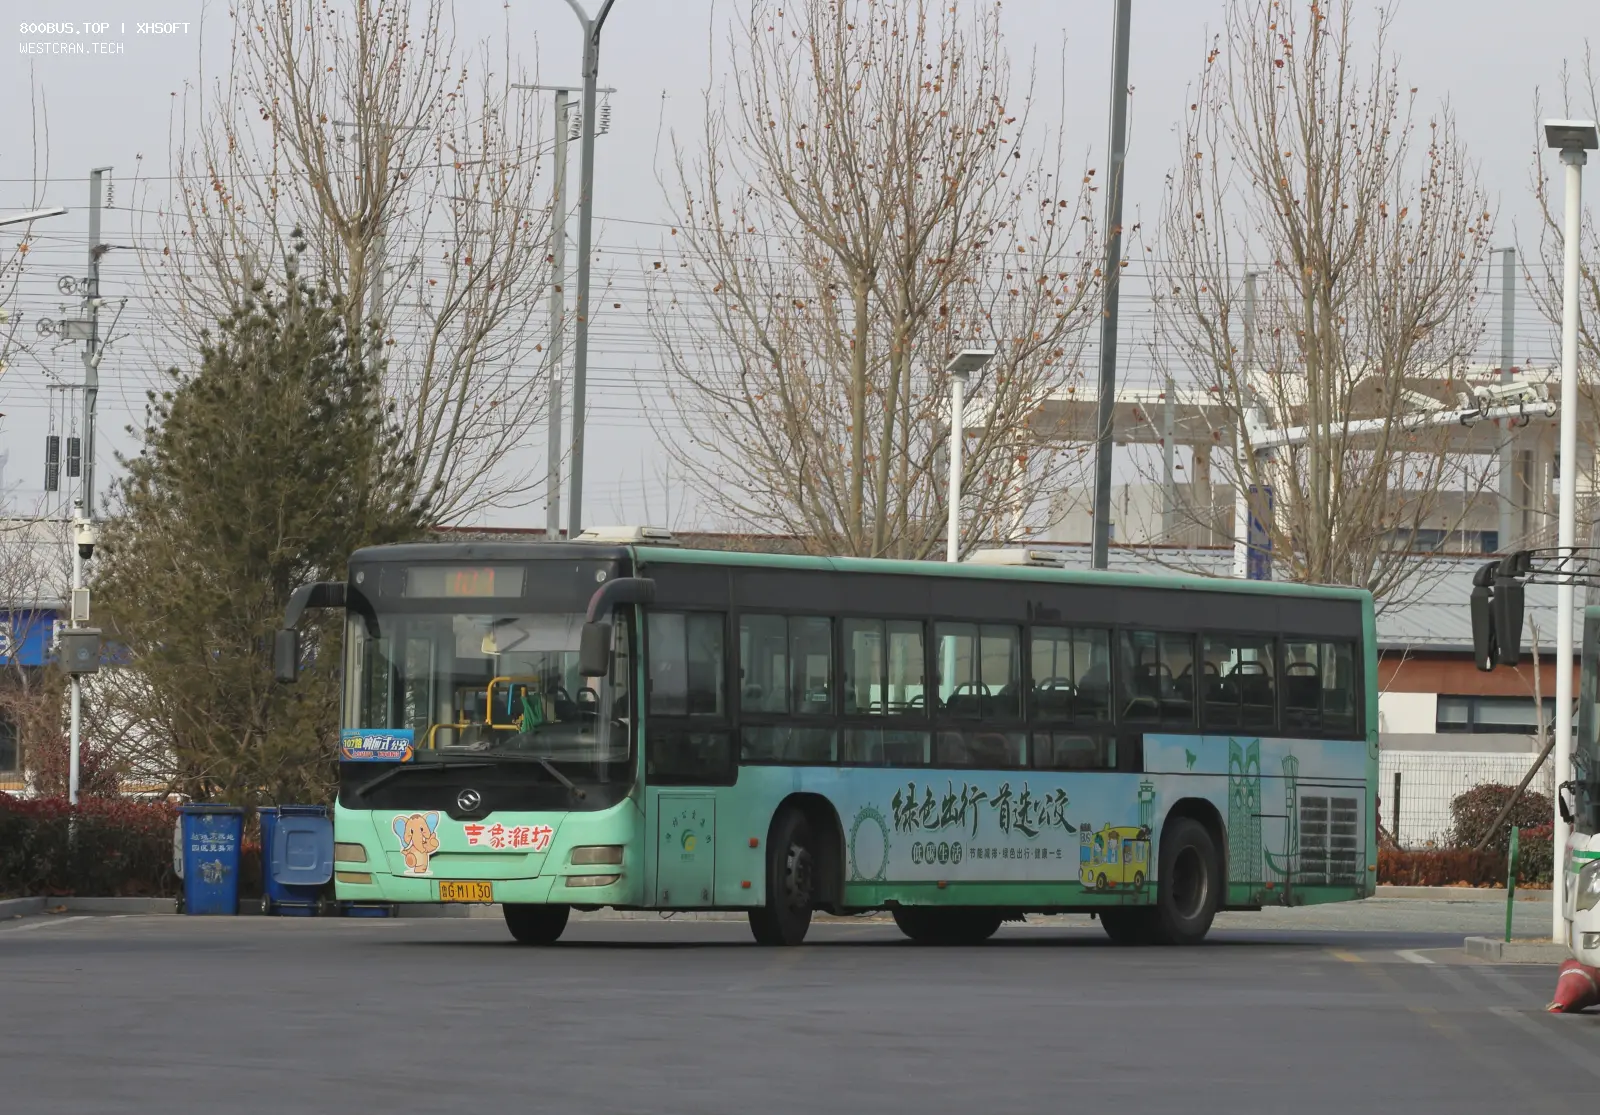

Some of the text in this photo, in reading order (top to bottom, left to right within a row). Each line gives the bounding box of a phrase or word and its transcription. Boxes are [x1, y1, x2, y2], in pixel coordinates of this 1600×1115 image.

[891, 780, 1077, 838] 绿色出行 首选公交
[912, 842, 963, 865] 低碳生活
